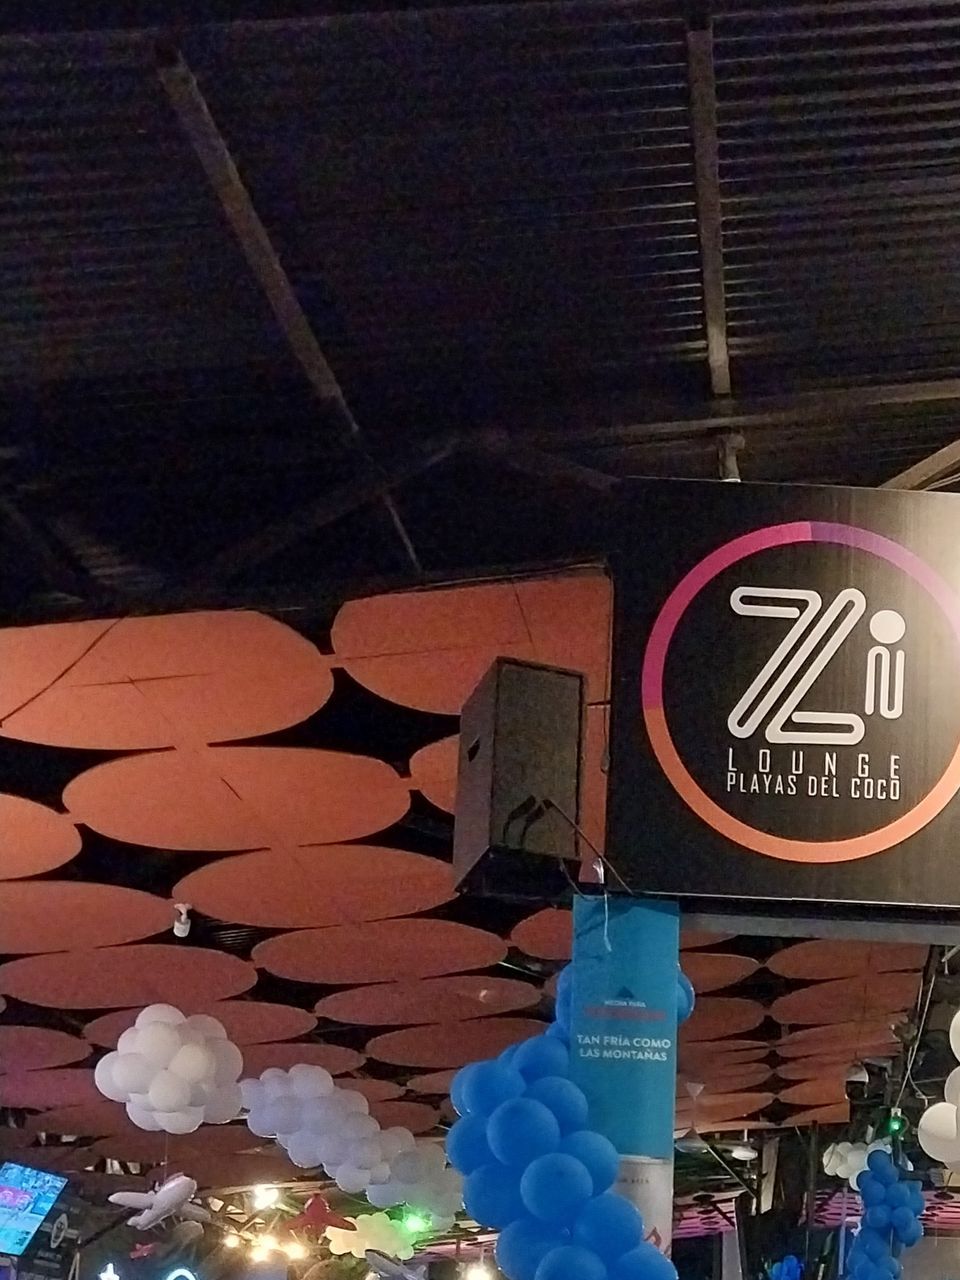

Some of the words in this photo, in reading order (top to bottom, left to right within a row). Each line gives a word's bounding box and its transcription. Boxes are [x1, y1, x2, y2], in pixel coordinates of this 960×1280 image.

[727, 747, 900, 779] LOUNGE
[727, 772, 797, 795] PLAYAS
[808, 776, 840, 797] DEL
[851, 778, 901, 800] COCO
[577, 1034, 600, 1045] TAN
[603, 1034, 630, 1047] FRÍA
[633, 1037, 671, 1049] COMO
[579, 1047, 600, 1058] LAS
[603, 1048, 668, 1062] MONTAÑAS
